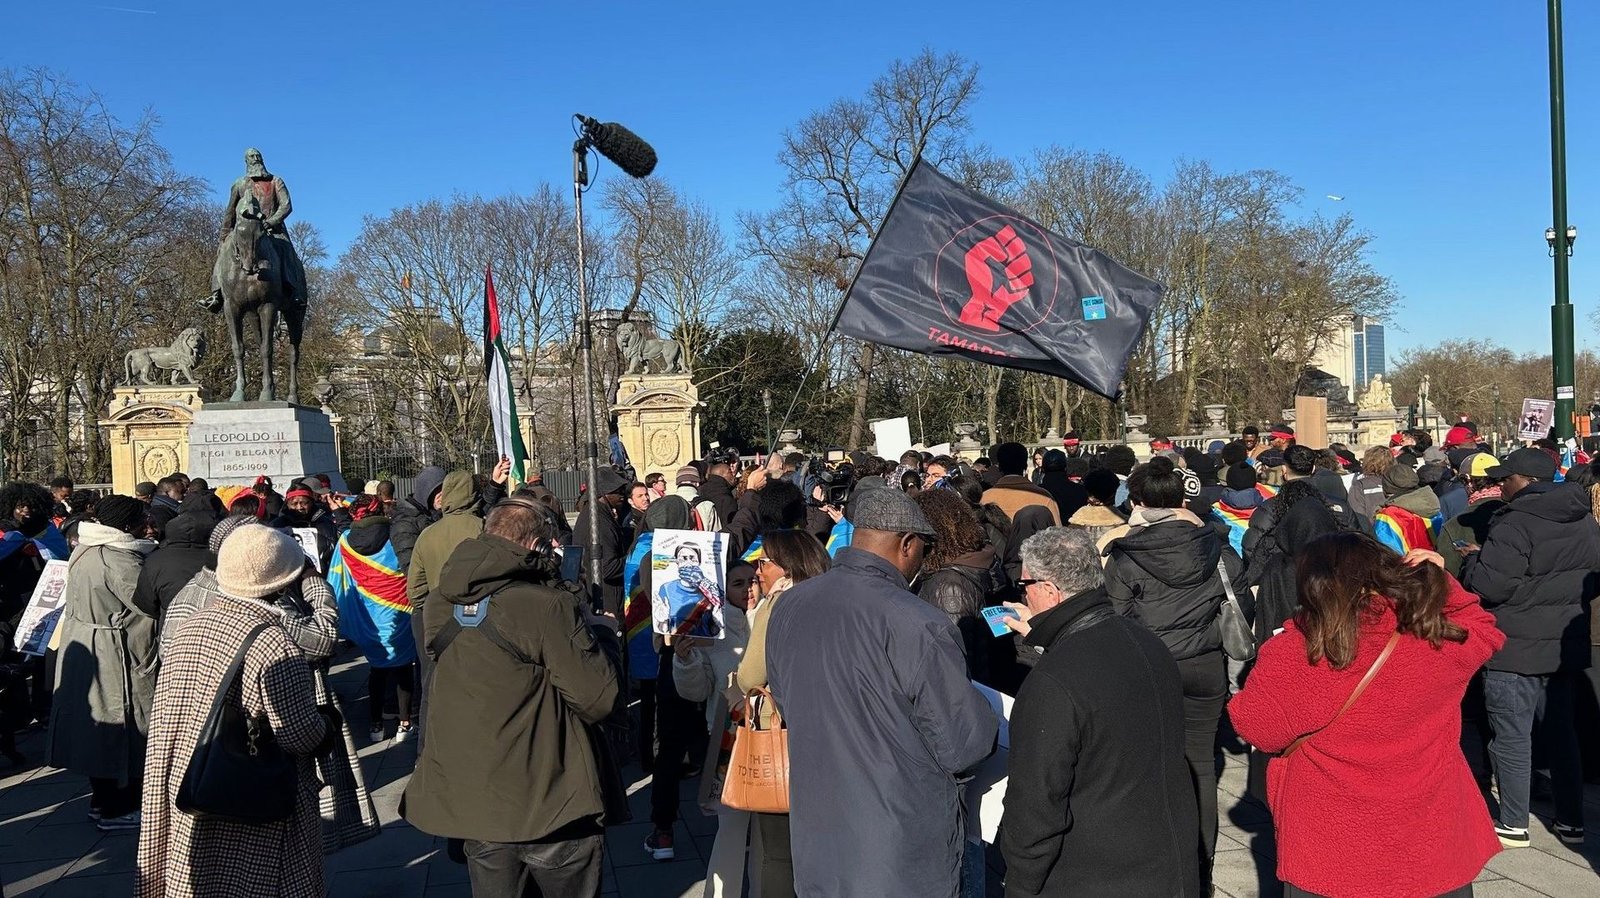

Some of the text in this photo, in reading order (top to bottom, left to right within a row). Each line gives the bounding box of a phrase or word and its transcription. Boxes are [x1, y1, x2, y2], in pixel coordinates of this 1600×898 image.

[204, 432, 270, 443] LEOPOLDO
[200, 448, 289, 458] REGI BELGARVM
[983, 608, 998, 617] FREE
[750, 754, 771, 765] THE
[738, 765, 760, 779] TOTE
